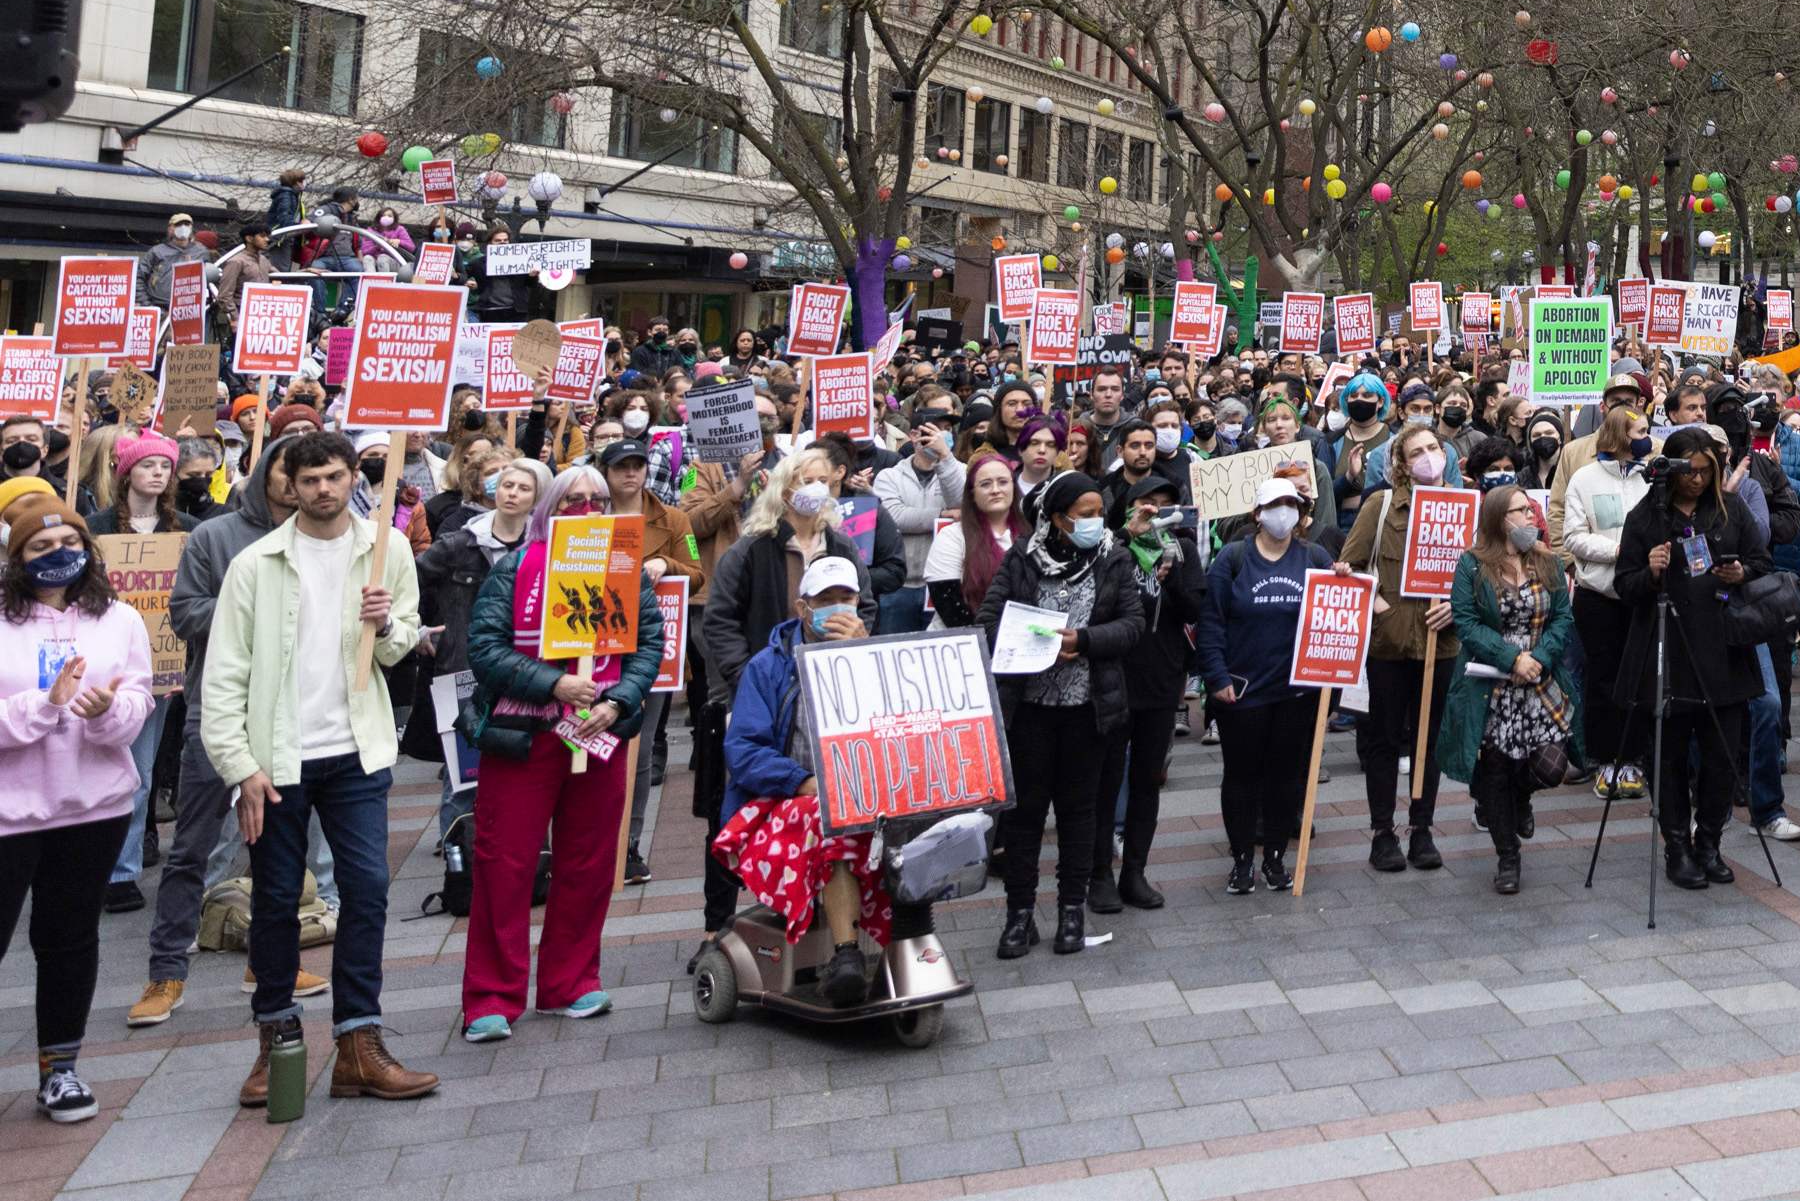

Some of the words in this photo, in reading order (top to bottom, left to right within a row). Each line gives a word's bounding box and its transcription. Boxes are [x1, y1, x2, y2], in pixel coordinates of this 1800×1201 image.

[490, 245, 538, 256] WOMEN'S
[540, 240, 586, 253] RIGHTS
[528, 253, 548, 262] ARE
[495, 261, 534, 275] HUMAN
[541, 259, 585, 271] RIGHTS
[1003, 262, 1034, 277] FIGHT
[68, 275, 84, 283] YOU
[85, 275, 107, 283] CAN'T
[108, 275, 128, 283] HAVE
[1005, 275, 1036, 290] BACK
[66, 284, 127, 296] CAPITALISM
[1415, 288, 1437, 298] FIGHT
[75, 297, 117, 307] WITHOUT
[805, 293, 841, 309] FIGHT
[1415, 297, 1437, 308] BACK
[1465, 300, 1488, 308] DEFEND
[1654, 293, 1681, 305] FIGHT
[173, 305, 200, 321] SEXISM
[249, 301, 303, 318] DEFEND
[803, 307, 837, 324] BACK
[1038, 302, 1078, 315] DEFEND
[1287, 303, 1319, 314] DEFEND
[1339, 304, 1369, 317] DEFEND
[1465, 307, 1480, 317] ROE
[1480, 308, 1487, 317] V.
[1542, 308, 1600, 322] ABORTION
[1653, 305, 1680, 318] BACK
[1697, 304, 1738, 319] RIGHTS
[64, 308, 125, 325] SEXISM
[370, 309, 392, 321] YOU
[393, 310, 423, 323] CAN'T
[425, 311, 452, 324] HAVE
[1036, 315, 1061, 331] ROE
[1065, 316, 1076, 332] V.
[1177, 312, 1210, 324] SEXISM
[1286, 314, 1307, 327] ROE
[1309, 315, 1318, 327] V.
[1339, 317, 1360, 329] ROE
[1362, 315, 1371, 327] V.
[1465, 316, 1487, 326] WADE
[247, 316, 282, 334] ROE
[284, 317, 300, 335] V.
[367, 323, 450, 342] CAPITALISM
[801, 323, 811, 331] TO
[811, 323, 834, 333] DEFEND
[1651, 324, 1679, 332] ABORTION
[799, 331, 833, 342] ABORTION
[1035, 331, 1075, 348] WADE
[1286, 327, 1317, 340] WADE
[1340, 328, 1372, 342] WADE
[1535, 329, 1552, 344] ON
[1556, 328, 1606, 343] DEMAND
[246, 335, 298, 355] WADE
[377, 342, 436, 358] WITHOUT
[560, 345, 599, 360] DEFEND
[189, 350, 213, 360] BODY
[1099, 350, 1131, 364] OWN
[1539, 351, 1547, 364] &
[1551, 349, 1603, 364] WITHOUT
[5, 357, 59, 371] ABORTION
[361, 357, 446, 384] SEXISM
[556, 357, 582, 373] ROE
[584, 360, 594, 374] V.
[819, 368, 842, 377] STAND
[843, 367, 853, 376] UP
[853, 366, 866, 375] FOR
[2, 370, 13, 382] &
[15, 370, 56, 384] LGBTQ
[555, 371, 593, 389] WADE
[819, 375, 866, 390] ABORTION
[1544, 370, 1597, 386] APOLOGY
[0, 384, 55, 401] RIGHTS
[819, 391, 829, 403] &
[831, 387, 866, 402] LGBTQ
[704, 393, 738, 409] FORCED
[691, 400, 754, 420] MOTHERHOOD
[819, 401, 867, 420] RIGHTS
[720, 416, 730, 426] IS
[708, 423, 745, 437] FEMALE
[1199, 459, 1233, 488] MY
[1243, 447, 1297, 479] BODY
[1201, 484, 1232, 513] MY
[1420, 501, 1469, 524] FIGHT
[568, 535, 609, 548] Socialist
[1417, 523, 1465, 547] BACK
[118, 540, 157, 564] IF
[566, 547, 608, 561] Feminist
[1416, 546, 1429, 558] TO
[552, 560, 605, 573] Resistance
[1252, 579, 1268, 593] CALL
[1269, 576, 1303, 592] CONGRESS
[662, 595, 679, 605] FOR
[1313, 584, 1365, 609] FIGHT
[1311, 607, 1361, 634] BACK
[1309, 632, 1321, 645] TO
[1323, 633, 1359, 648] DEFEND
[1306, 646, 1357, 661] ABORTION
[813, 655, 860, 729] NO
[869, 641, 985, 717] JUSTICE
[872, 715, 896, 726] END
[830, 740, 879, 820] NO
